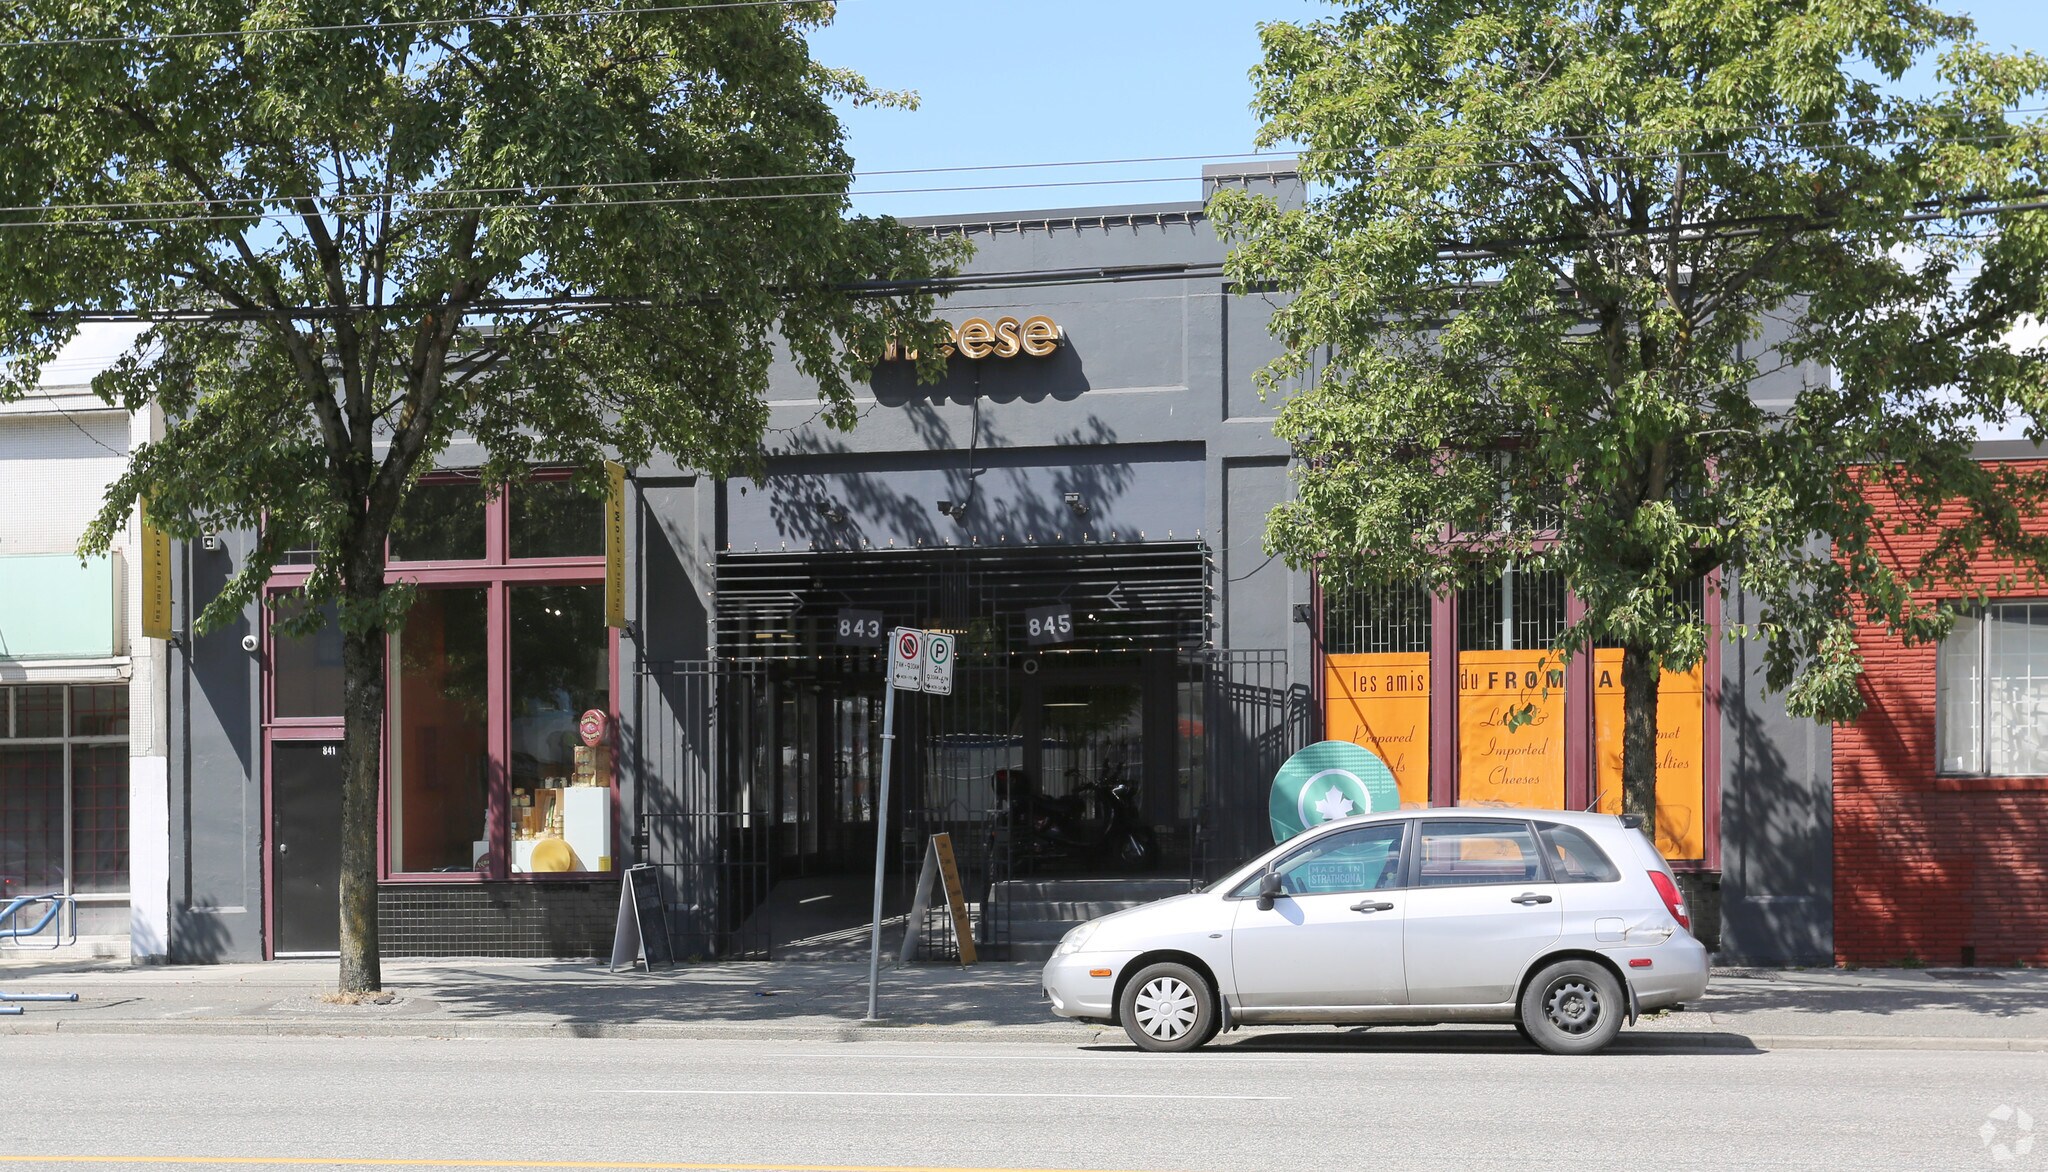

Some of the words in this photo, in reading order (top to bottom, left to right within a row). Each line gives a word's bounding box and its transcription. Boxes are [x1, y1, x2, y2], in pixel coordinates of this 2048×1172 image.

[616, 557, 621, 568] du
[156, 570, 162, 581] du
[839, 619, 880, 638] 843
[1028, 614, 1072, 637] 845
[936, 644, 944, 658] P
[934, 666, 942, 674] 2h
[1353, 671, 1377, 692] les
[1386, 670, 1424, 692] amis
[1460, 668, 1478, 690] du
[1352, 724, 1416, 749] Prepared
[322, 745, 336, 756] 841
[1480, 736, 1550, 761] Imported
[1488, 764, 1541, 785] Cheeses
[1310, 865, 1343, 874] MADE
[1348, 864, 1361, 873] IN
[1311, 872, 1362, 885] STRATHCONA
